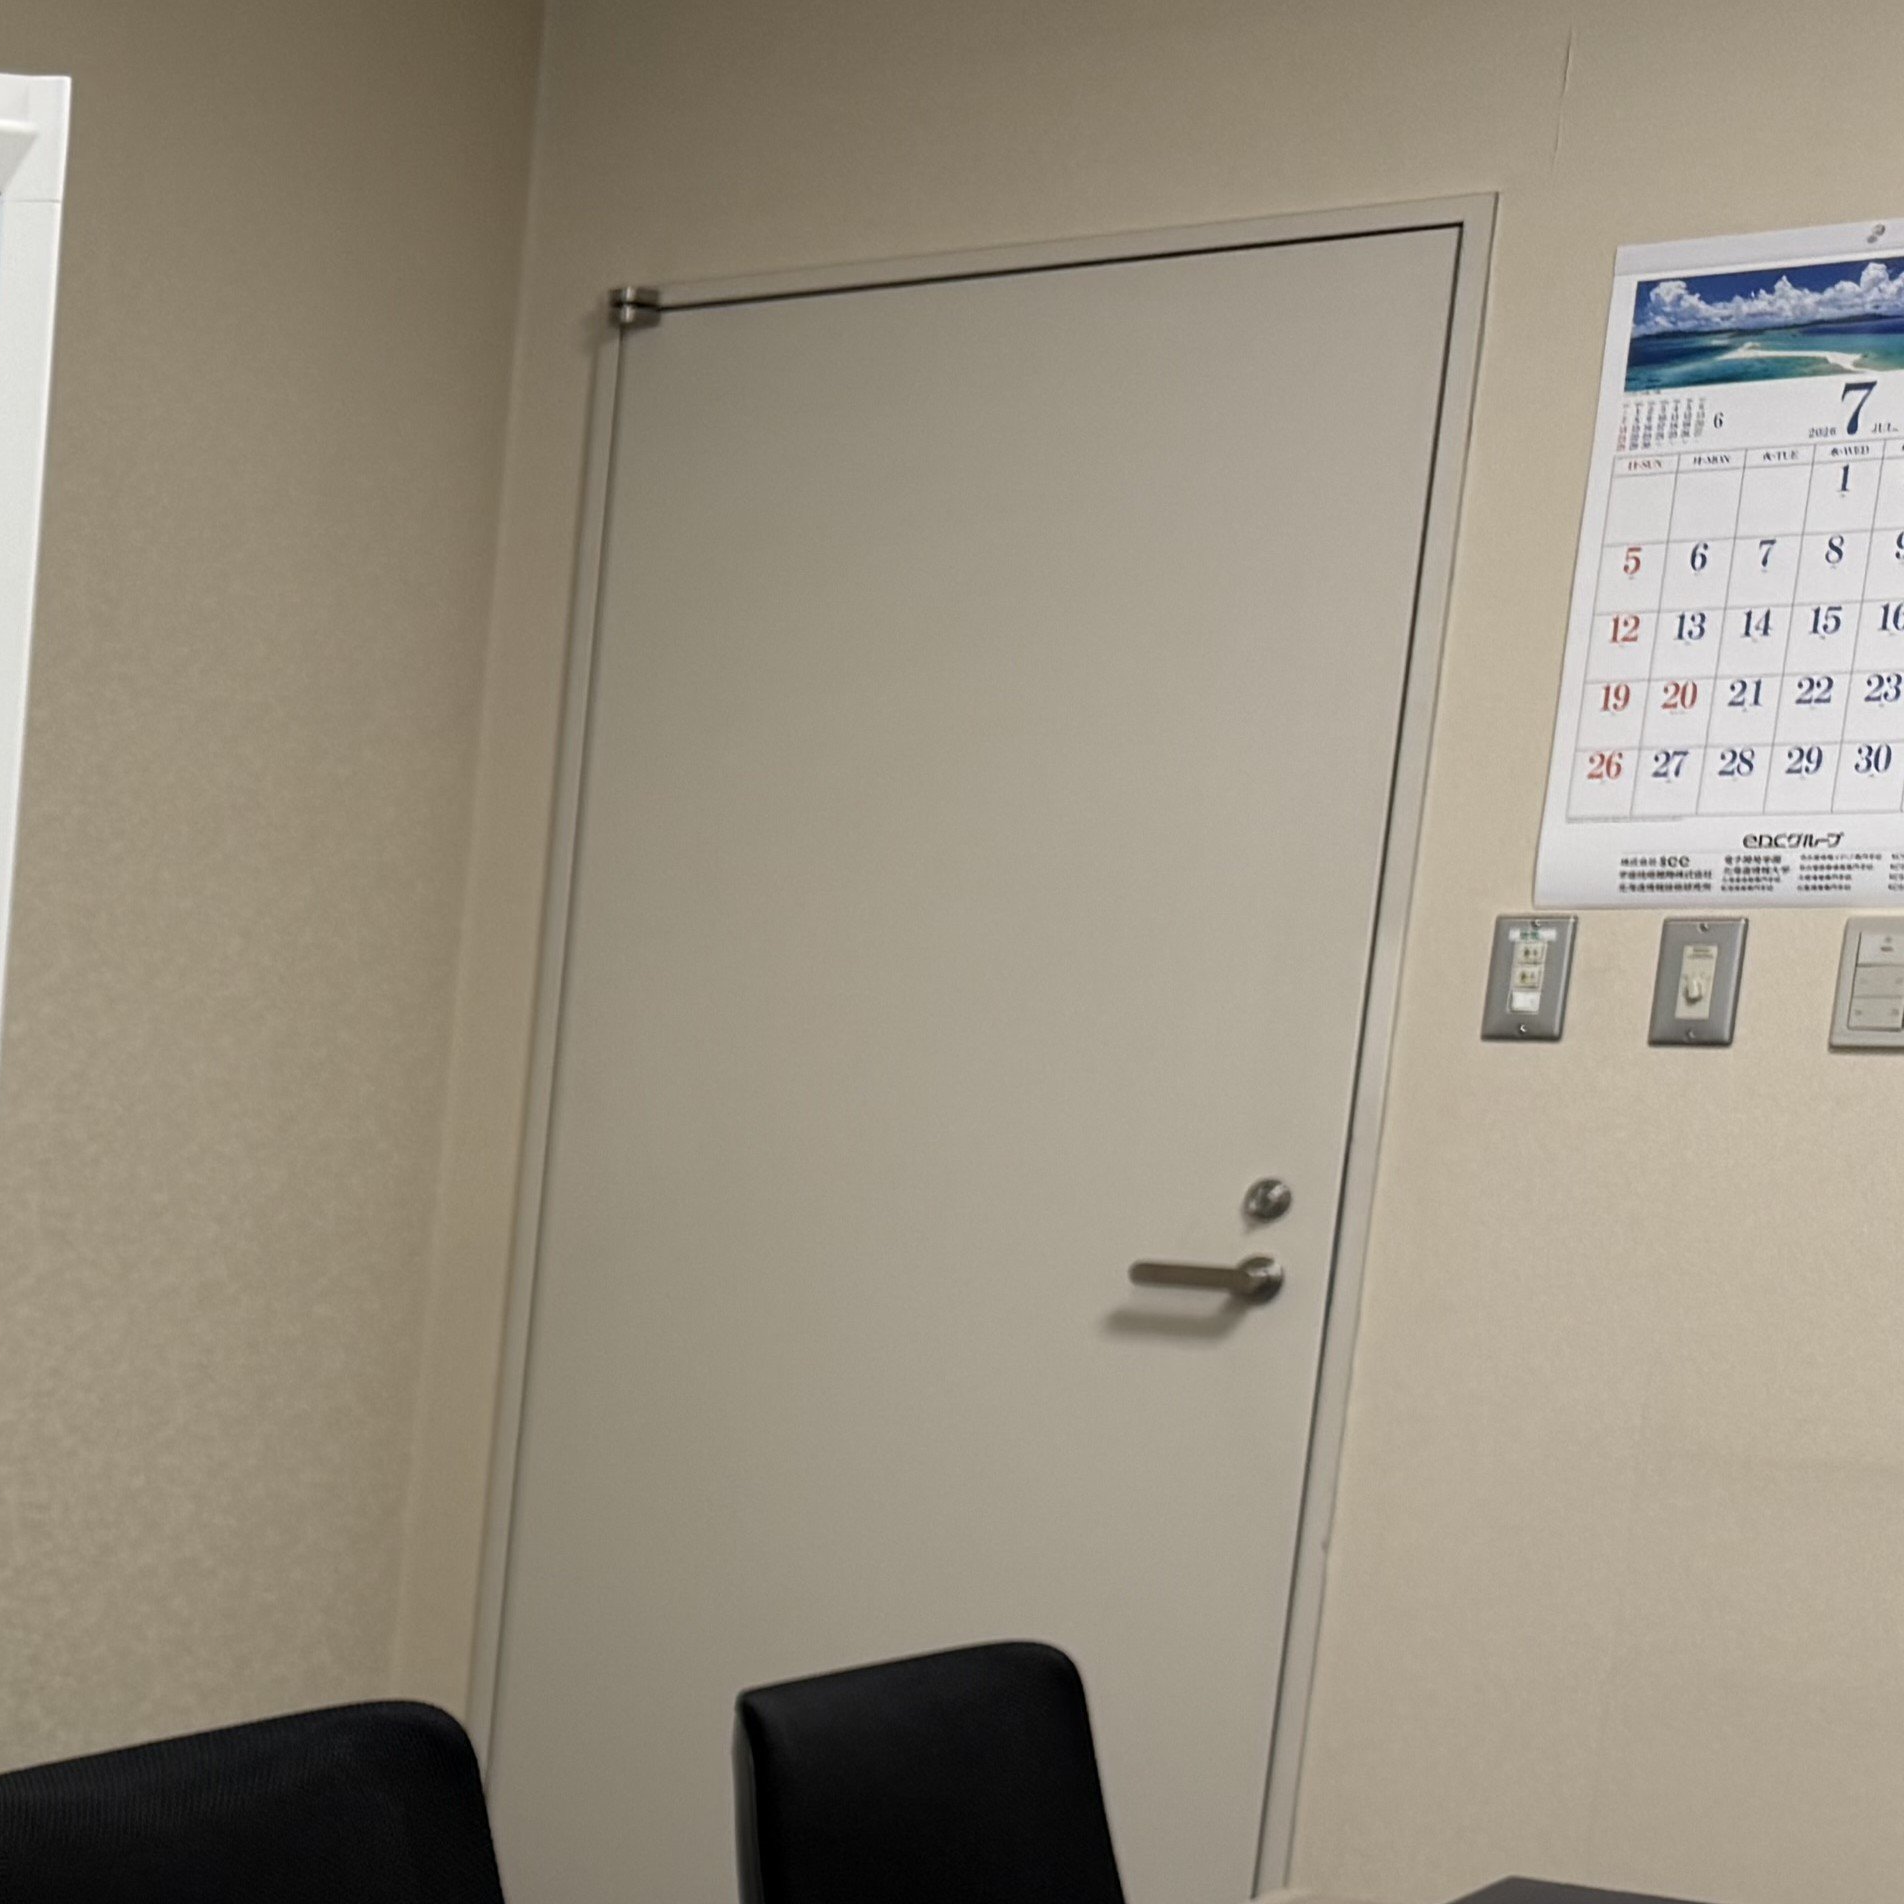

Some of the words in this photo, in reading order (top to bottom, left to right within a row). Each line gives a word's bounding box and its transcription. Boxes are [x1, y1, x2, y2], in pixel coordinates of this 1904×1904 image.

[1713, 412, 1724, 429] 6
[1841, 380, 1877, 435] 7
[1838, 464, 1849, 493] 1
[1623, 547, 1642, 575] 5
[1690, 543, 1708, 572] 6
[1759, 539, 1777, 568] 7
[1825, 535, 1844, 564] 8
[1608, 615, 1641, 644] 12
[1673, 612, 1707, 641] 13
[1741, 609, 1773, 638] 14
[1808, 606, 1842, 635] 15
[1599, 684, 1630, 713] 19
[1661, 681, 1698, 710] 20
[1728, 679, 1764, 708] 21
[1796, 677, 1834, 704] 22
[1864, 673, 1903, 702] 23
[1587, 751, 1623, 780] 26
[1652, 750, 1690, 779] 27
[1718, 748, 1755, 777] 28
[1785, 746, 1823, 774] 29
[1854, 744, 1892, 774] 30
